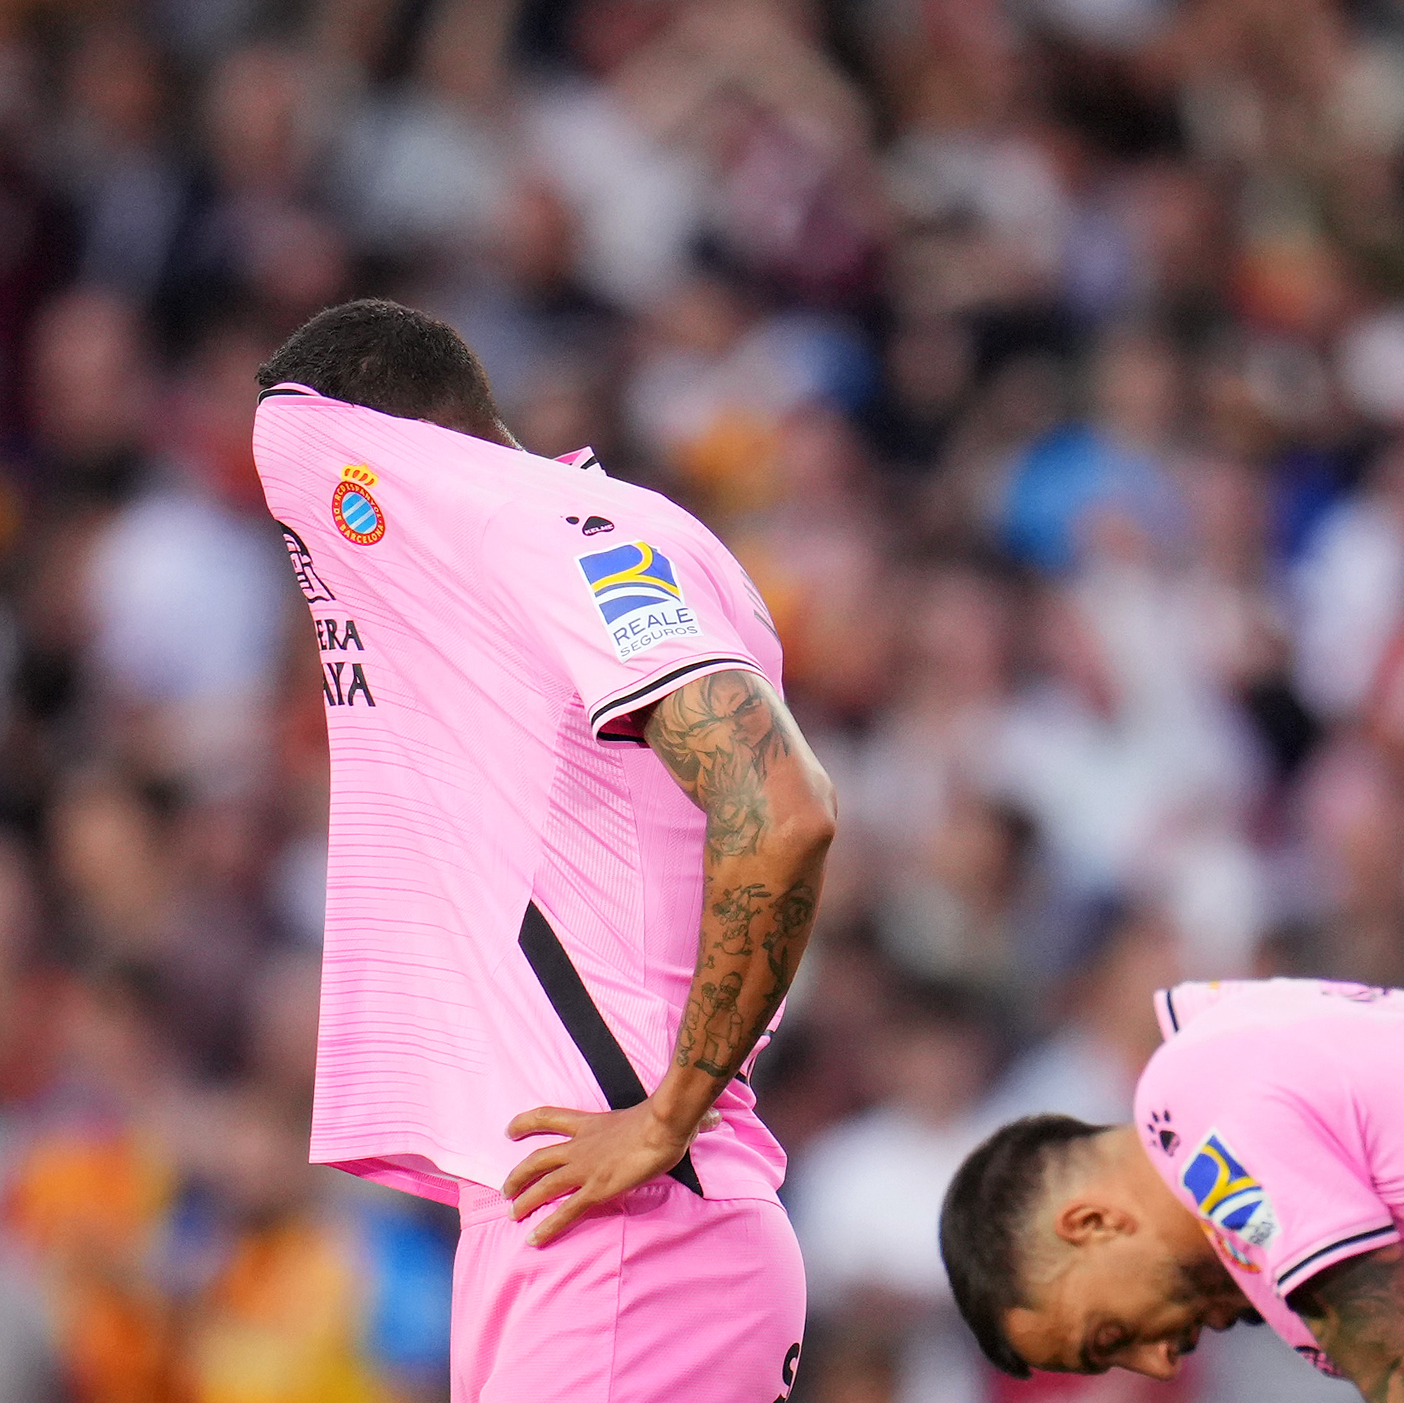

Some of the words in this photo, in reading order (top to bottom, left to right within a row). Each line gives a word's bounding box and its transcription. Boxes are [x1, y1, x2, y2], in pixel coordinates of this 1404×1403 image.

[339, 523, 385, 544] BARCELONA
[584, 524, 614, 535] KELME
[613, 607, 694, 646] REALE
[620, 625, 699, 657] SEGUROS
